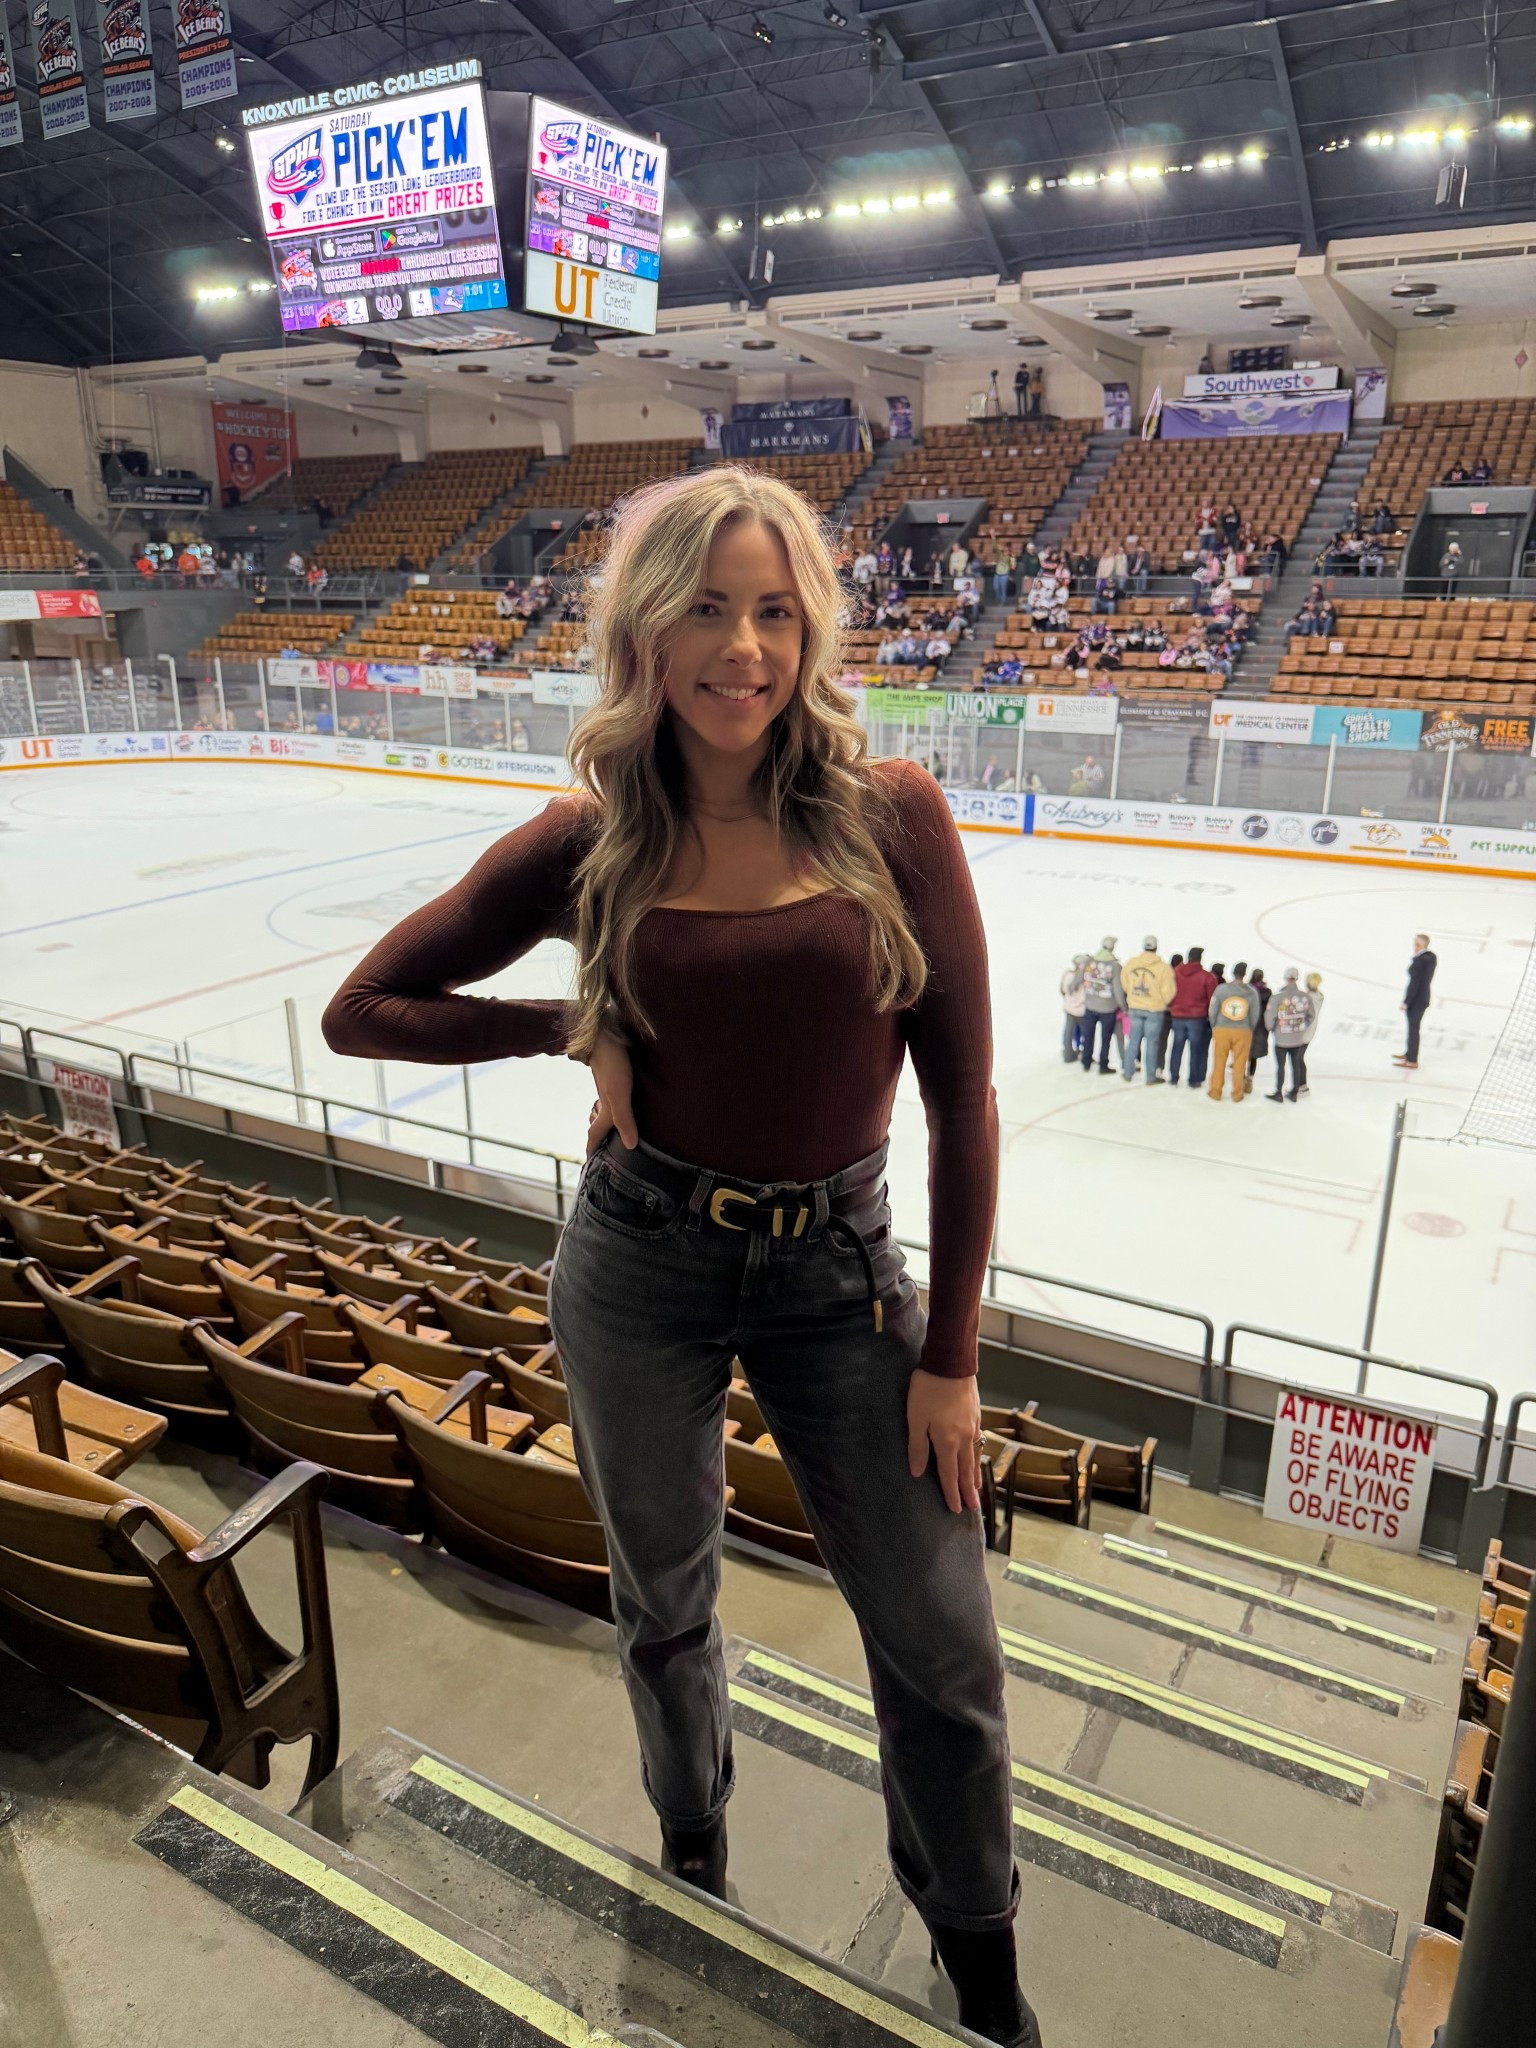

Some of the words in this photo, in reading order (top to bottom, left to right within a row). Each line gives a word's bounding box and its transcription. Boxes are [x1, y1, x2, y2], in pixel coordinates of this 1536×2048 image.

[177, 23, 196, 45] ICE
[194, 11, 225, 37] BEARS
[102, 38, 119, 60] ICE
[118, 31, 147, 56] BEARS
[178, 42, 216, 60] PRESIDENT'S
[217, 38, 230, 50] CUP
[54, 48, 78, 73] BEARS
[181, 58, 232, 83] CHAMPIONS
[106, 78, 152, 98] CHAMPIONS
[185, 77, 232, 98] 2005-2006
[242, 92, 331, 126] KNOXVILLE
[333, 83, 382, 106] CIVIC
[383, 59, 479, 96] COLISEUM
[42, 94, 86, 116] CHAMPIONS
[108, 96, 152, 113] 2007-2008
[329, 111, 372, 133] SATURDAY
[546, 123, 579, 140] SPHL
[273, 132, 320, 180] SPHL
[331, 106, 468, 188] PICK'EM
[583, 132, 658, 187] PICK'EM
[316, 191, 337, 206] CLIMB
[340, 188, 350, 200] UP
[353, 186, 367, 199] THE
[370, 181, 398, 197] SEASON
[402, 177, 422, 192] LONG
[425, 166, 482, 188] LEADERBOARD
[302, 211, 316, 224] FOR
[326, 205, 354, 220] CHANCE
[358, 202, 367, 214] TO
[370, 199, 383, 212] WIN
[388, 191, 428, 217] GREAT
[435, 182, 483, 210] PRIZES
[493, 283, 500, 294] 2
[555, 261, 600, 320] UT
[604, 273, 637, 294] Federal
[353, 301, 361, 315] 2
[604, 292, 631, 311] Credit
[603, 308, 631, 326] Union
[1205, 373, 1302, 393] Southwest
[750, 434, 830, 448] MARKMANS
[946, 693, 998, 718] UNION
[997, 698, 1025, 707] PLACE
[1214, 714, 1233, 726] UT
[1235, 720, 1273, 729] MEDICAL
[1275, 721, 1309, 731] CENTER
[1349, 718, 1391, 733] HEALTH
[1437, 719, 1460, 730] OLD
[1483, 718, 1529, 738] FREE
[1348, 729, 1390, 744] SHOPPE
[1421, 726, 1480, 747] TENNESSEE
[1480, 735, 1531, 747] TASTINGS
[21, 739, 54, 759] UT
[1042, 800, 1124, 829] Aubrey's
[1470, 840, 1491, 850] PET
[54, 1063, 109, 1097] ATTENTION
[1279, 1393, 1434, 1456] ATTENTION
[1290, 1429, 1323, 1460] BE
[1327, 1440, 1416, 1484] AWARE
[1287, 1460, 1319, 1487] OF
[1325, 1469, 1410, 1512] FLYING
[1288, 1490, 1399, 1538] OBJECTS
